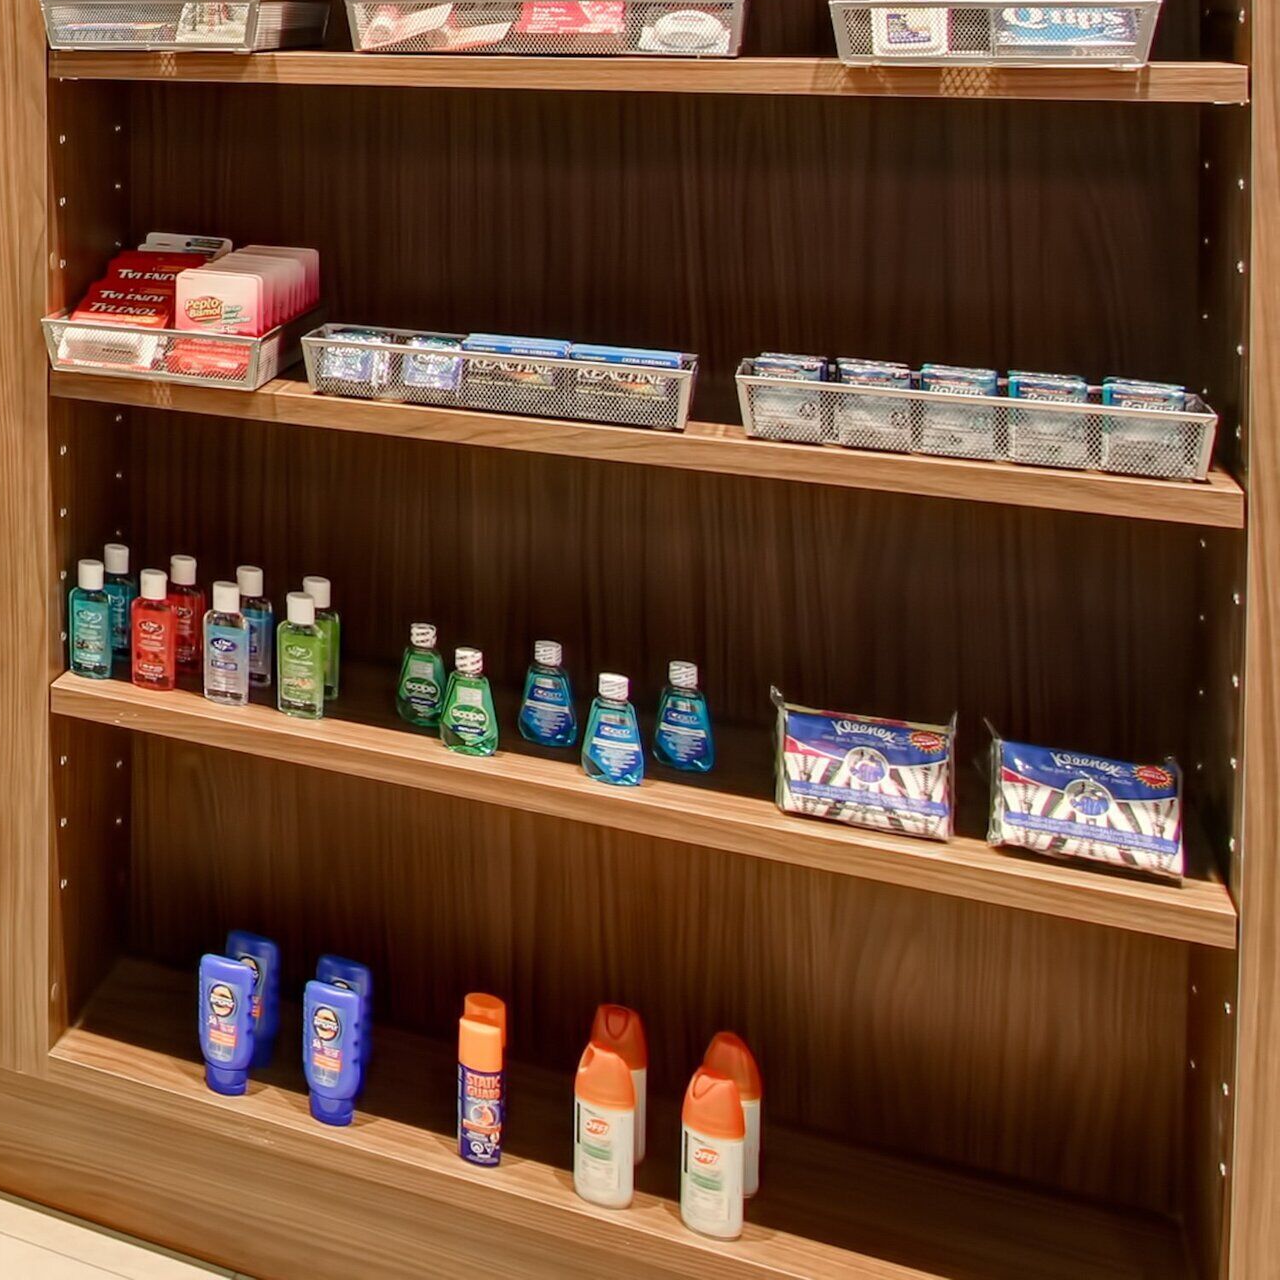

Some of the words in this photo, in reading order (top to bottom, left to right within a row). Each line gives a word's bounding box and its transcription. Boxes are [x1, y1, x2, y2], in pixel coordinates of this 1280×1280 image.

[90, 301, 156, 317] TYLENOL
[184, 298, 221, 312] Pepto
[831, 720, 896, 743] Kleenex
[1049, 751, 1121, 777] Kleenex
[466, 1072, 500, 1089] STATIC
[466, 1085, 500, 1100] GUARD
[586, 1120, 609, 1135] OFF!
[695, 1149, 719, 1163] OFF!
